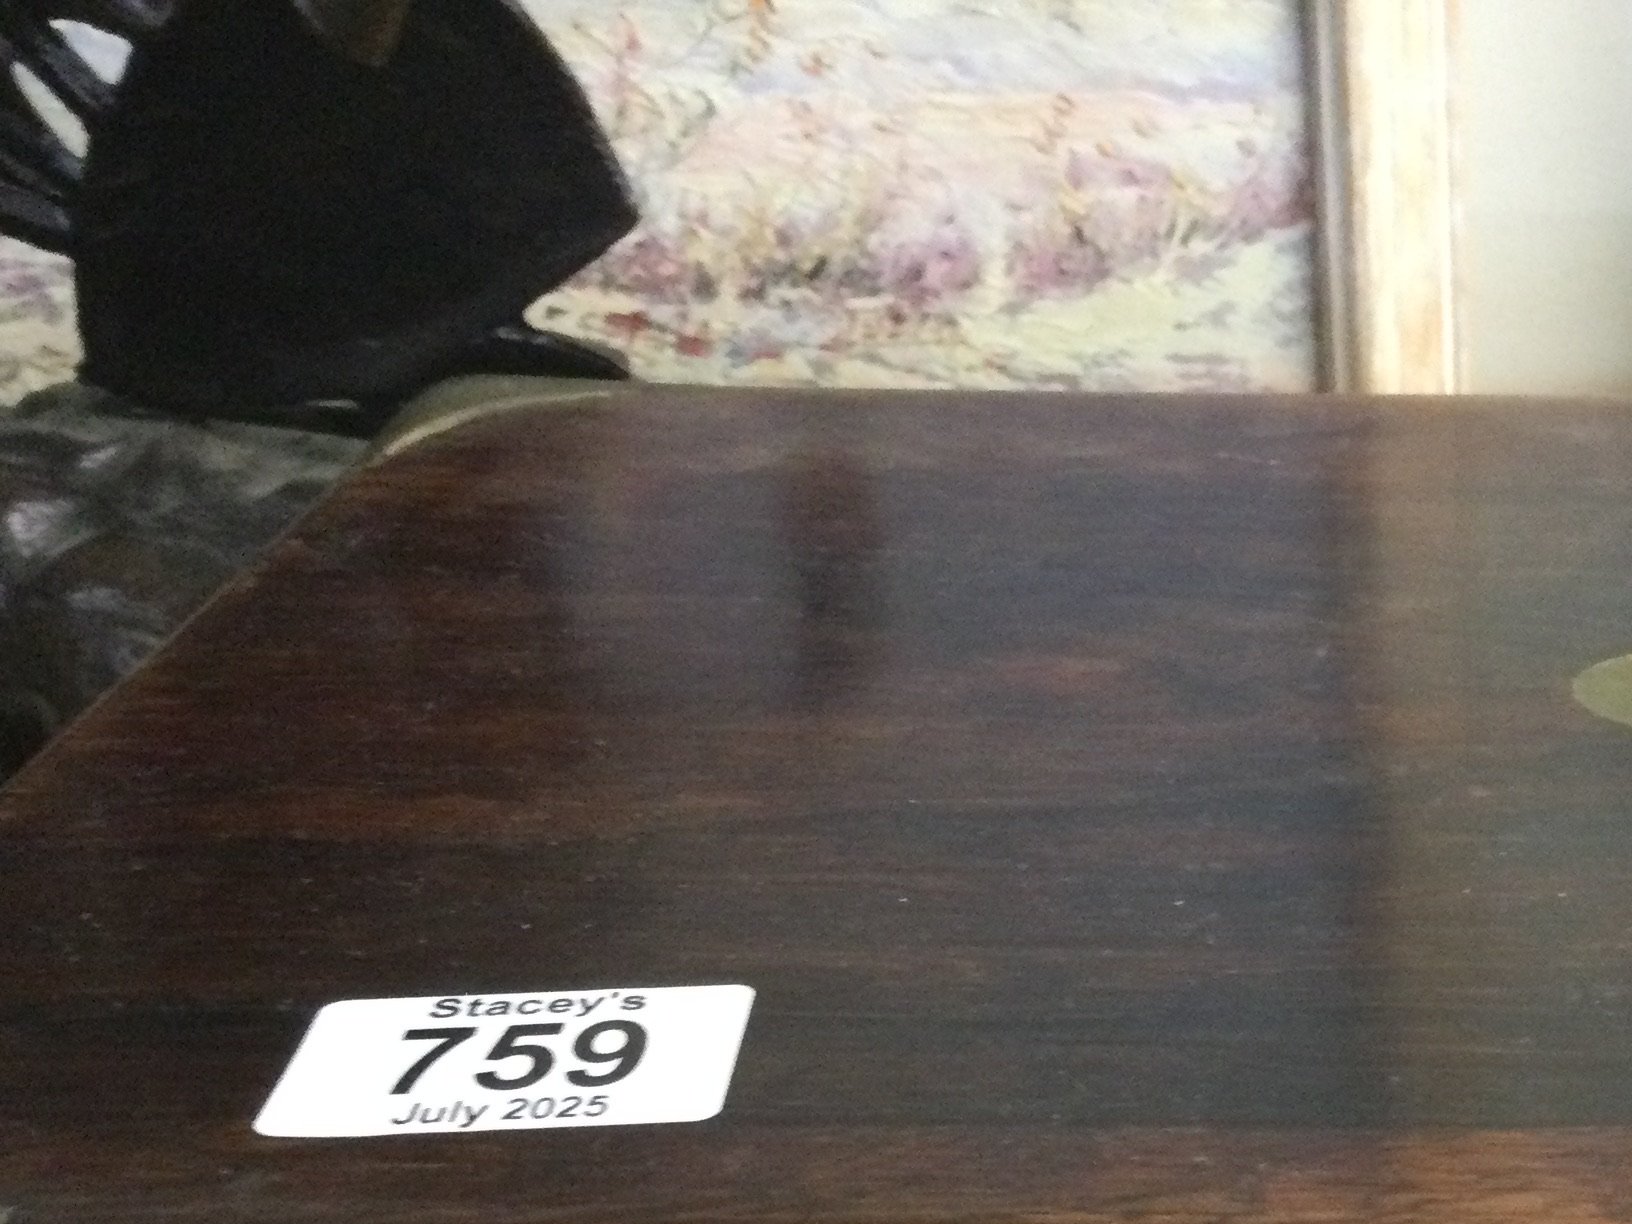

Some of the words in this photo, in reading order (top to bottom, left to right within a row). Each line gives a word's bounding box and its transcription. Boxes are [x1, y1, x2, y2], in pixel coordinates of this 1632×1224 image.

[429, 991, 648, 1018] Stacey's
[390, 1019, 648, 1096] 759
[390, 1099, 490, 1128] July
[503, 1096, 610, 1121] 2025
